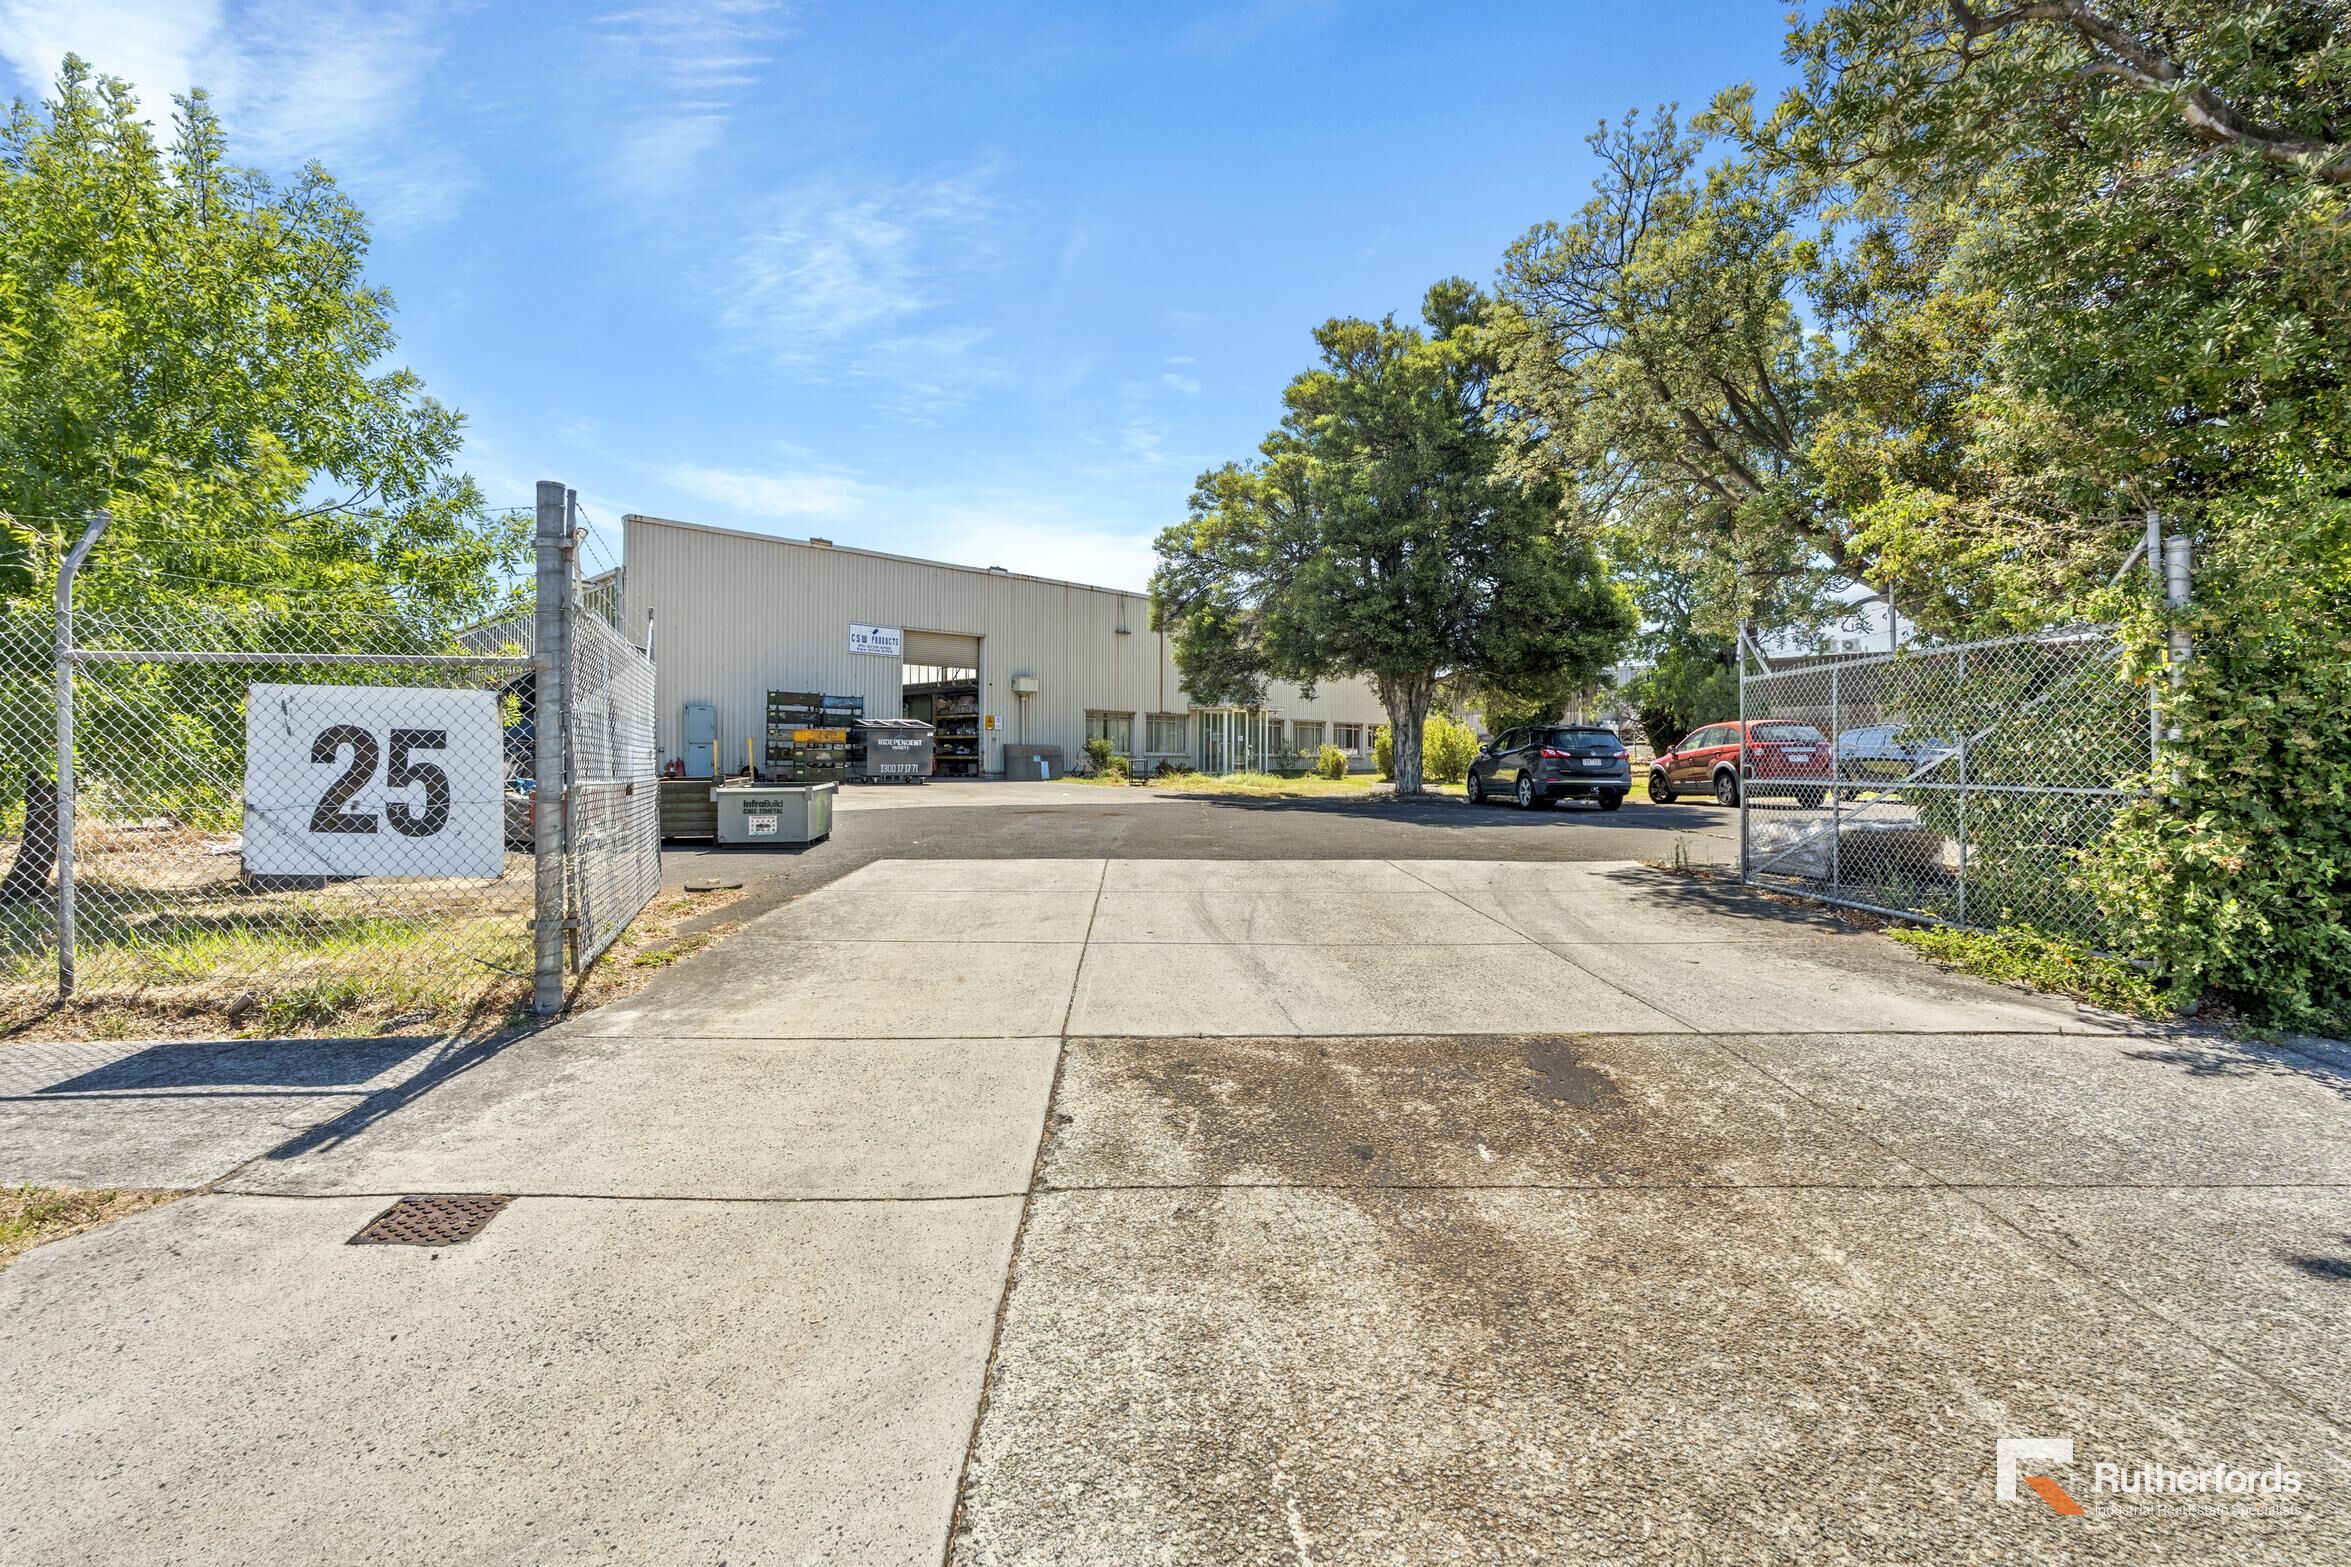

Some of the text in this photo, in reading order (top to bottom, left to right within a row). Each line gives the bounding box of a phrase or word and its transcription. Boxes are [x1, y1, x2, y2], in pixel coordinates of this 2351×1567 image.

[851, 633, 899, 646] CSW PRODUCTS
[878, 738, 922, 746] INDEPENDENT
[880, 764, 896, 773] 1300
[308, 724, 450, 837] 25
[743, 799, 784, 808] InfraBuild
